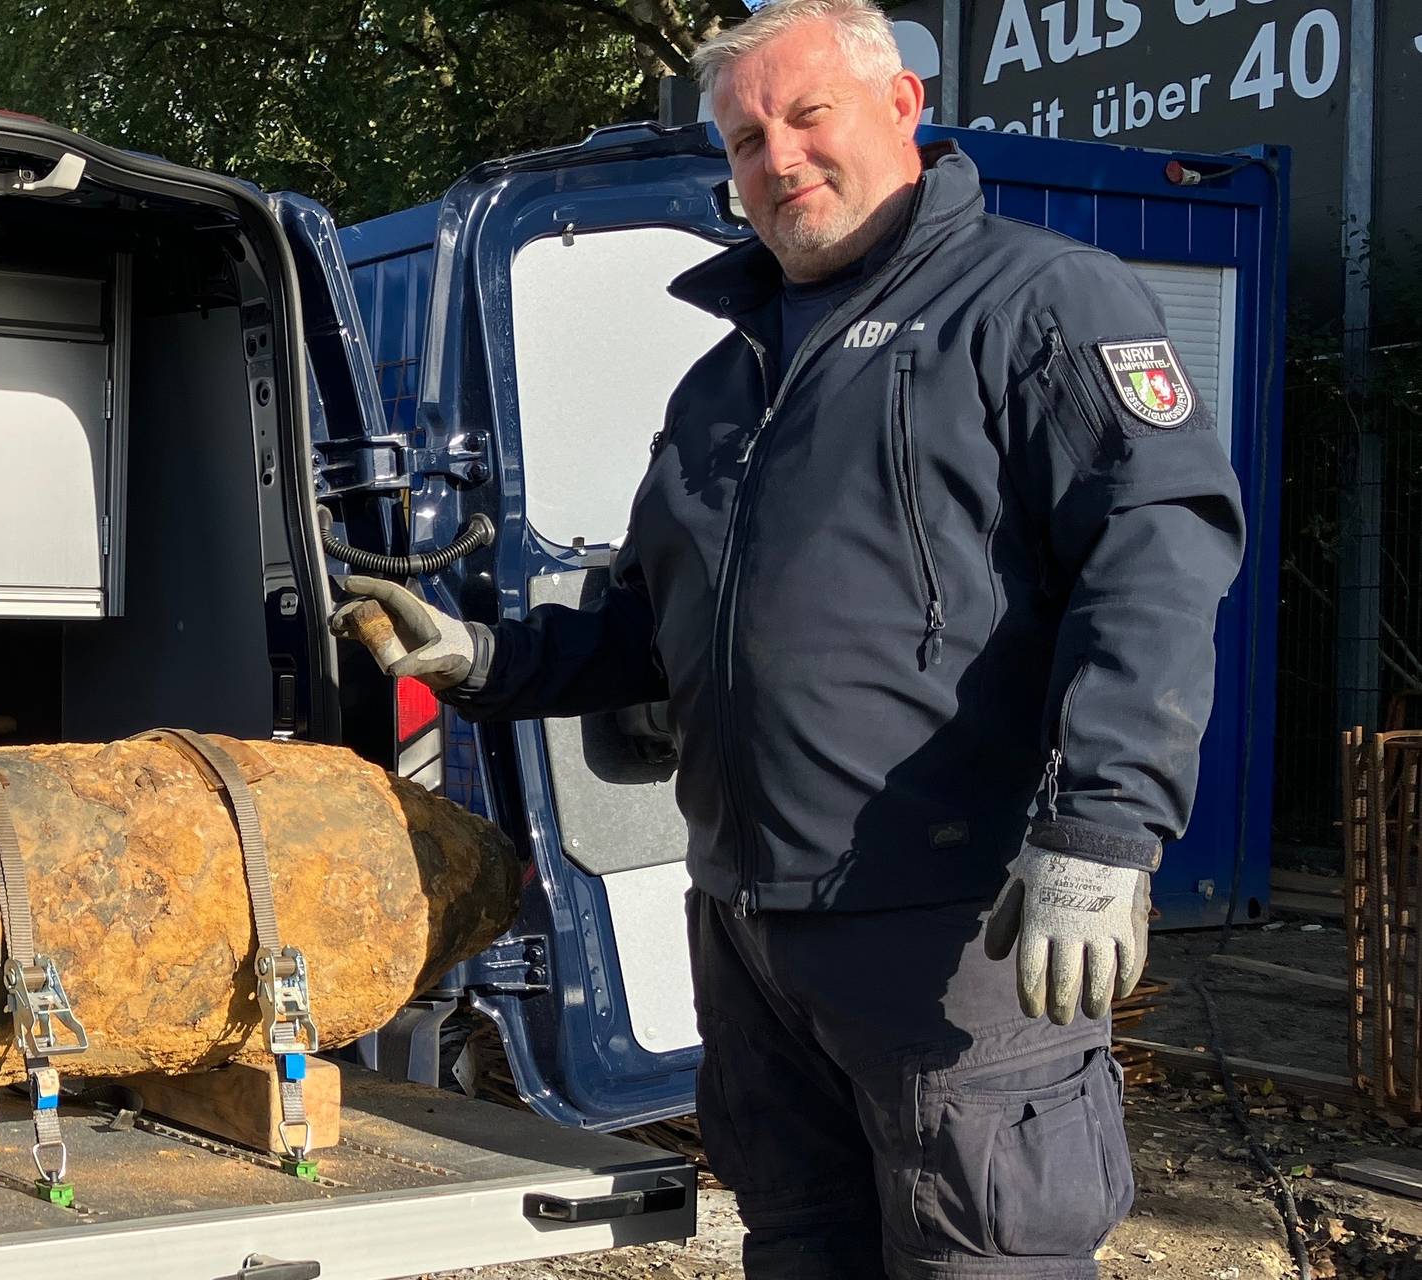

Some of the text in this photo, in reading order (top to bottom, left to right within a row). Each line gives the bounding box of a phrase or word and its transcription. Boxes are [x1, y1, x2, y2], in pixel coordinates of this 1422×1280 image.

[982, 0, 1142, 85] Aus
[1092, 73, 1211, 138] über
[1229, 8, 1341, 110] 40
[843, 320, 898, 348] KBD
[1119, 347, 1155, 361] NRW
[1124, 381, 1189, 421] BESEITIGUNGSDIENST
